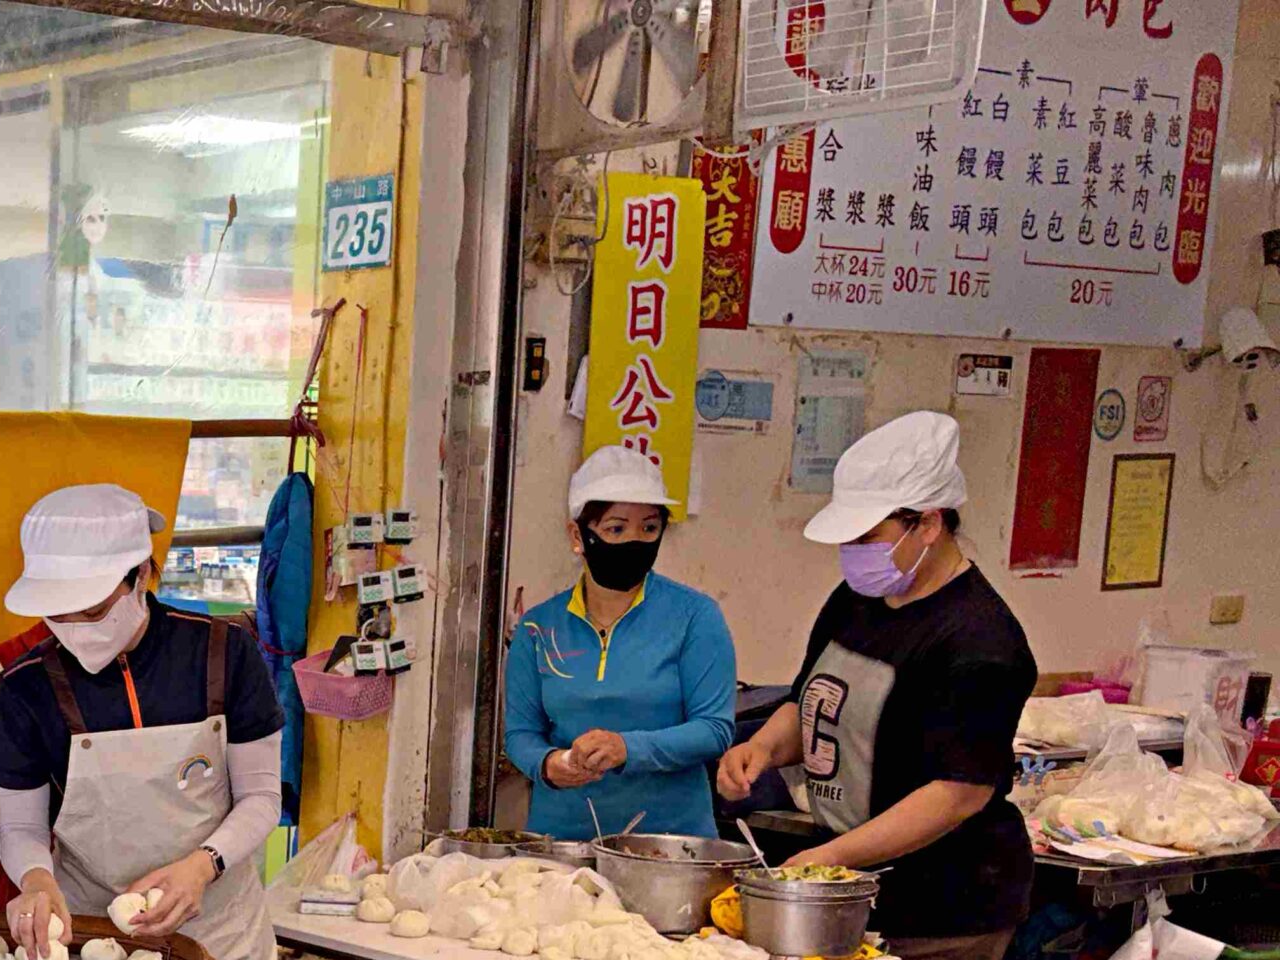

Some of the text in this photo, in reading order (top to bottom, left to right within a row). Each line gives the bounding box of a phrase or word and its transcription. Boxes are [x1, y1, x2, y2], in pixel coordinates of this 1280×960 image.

[331, 179, 390, 201] 中山路
[1021, 96, 1052, 240] 素菜包
[1047, 101, 1078, 243] 紅豆包
[1177, 74, 1220, 265] 歡迎光臨
[330, 207, 388, 260] 235
[893, 266, 937, 295] 30元
[947, 269, 992, 298] 16元
[1070, 279, 1114, 307] 20元
[612, 196, 677, 466] 明日公
